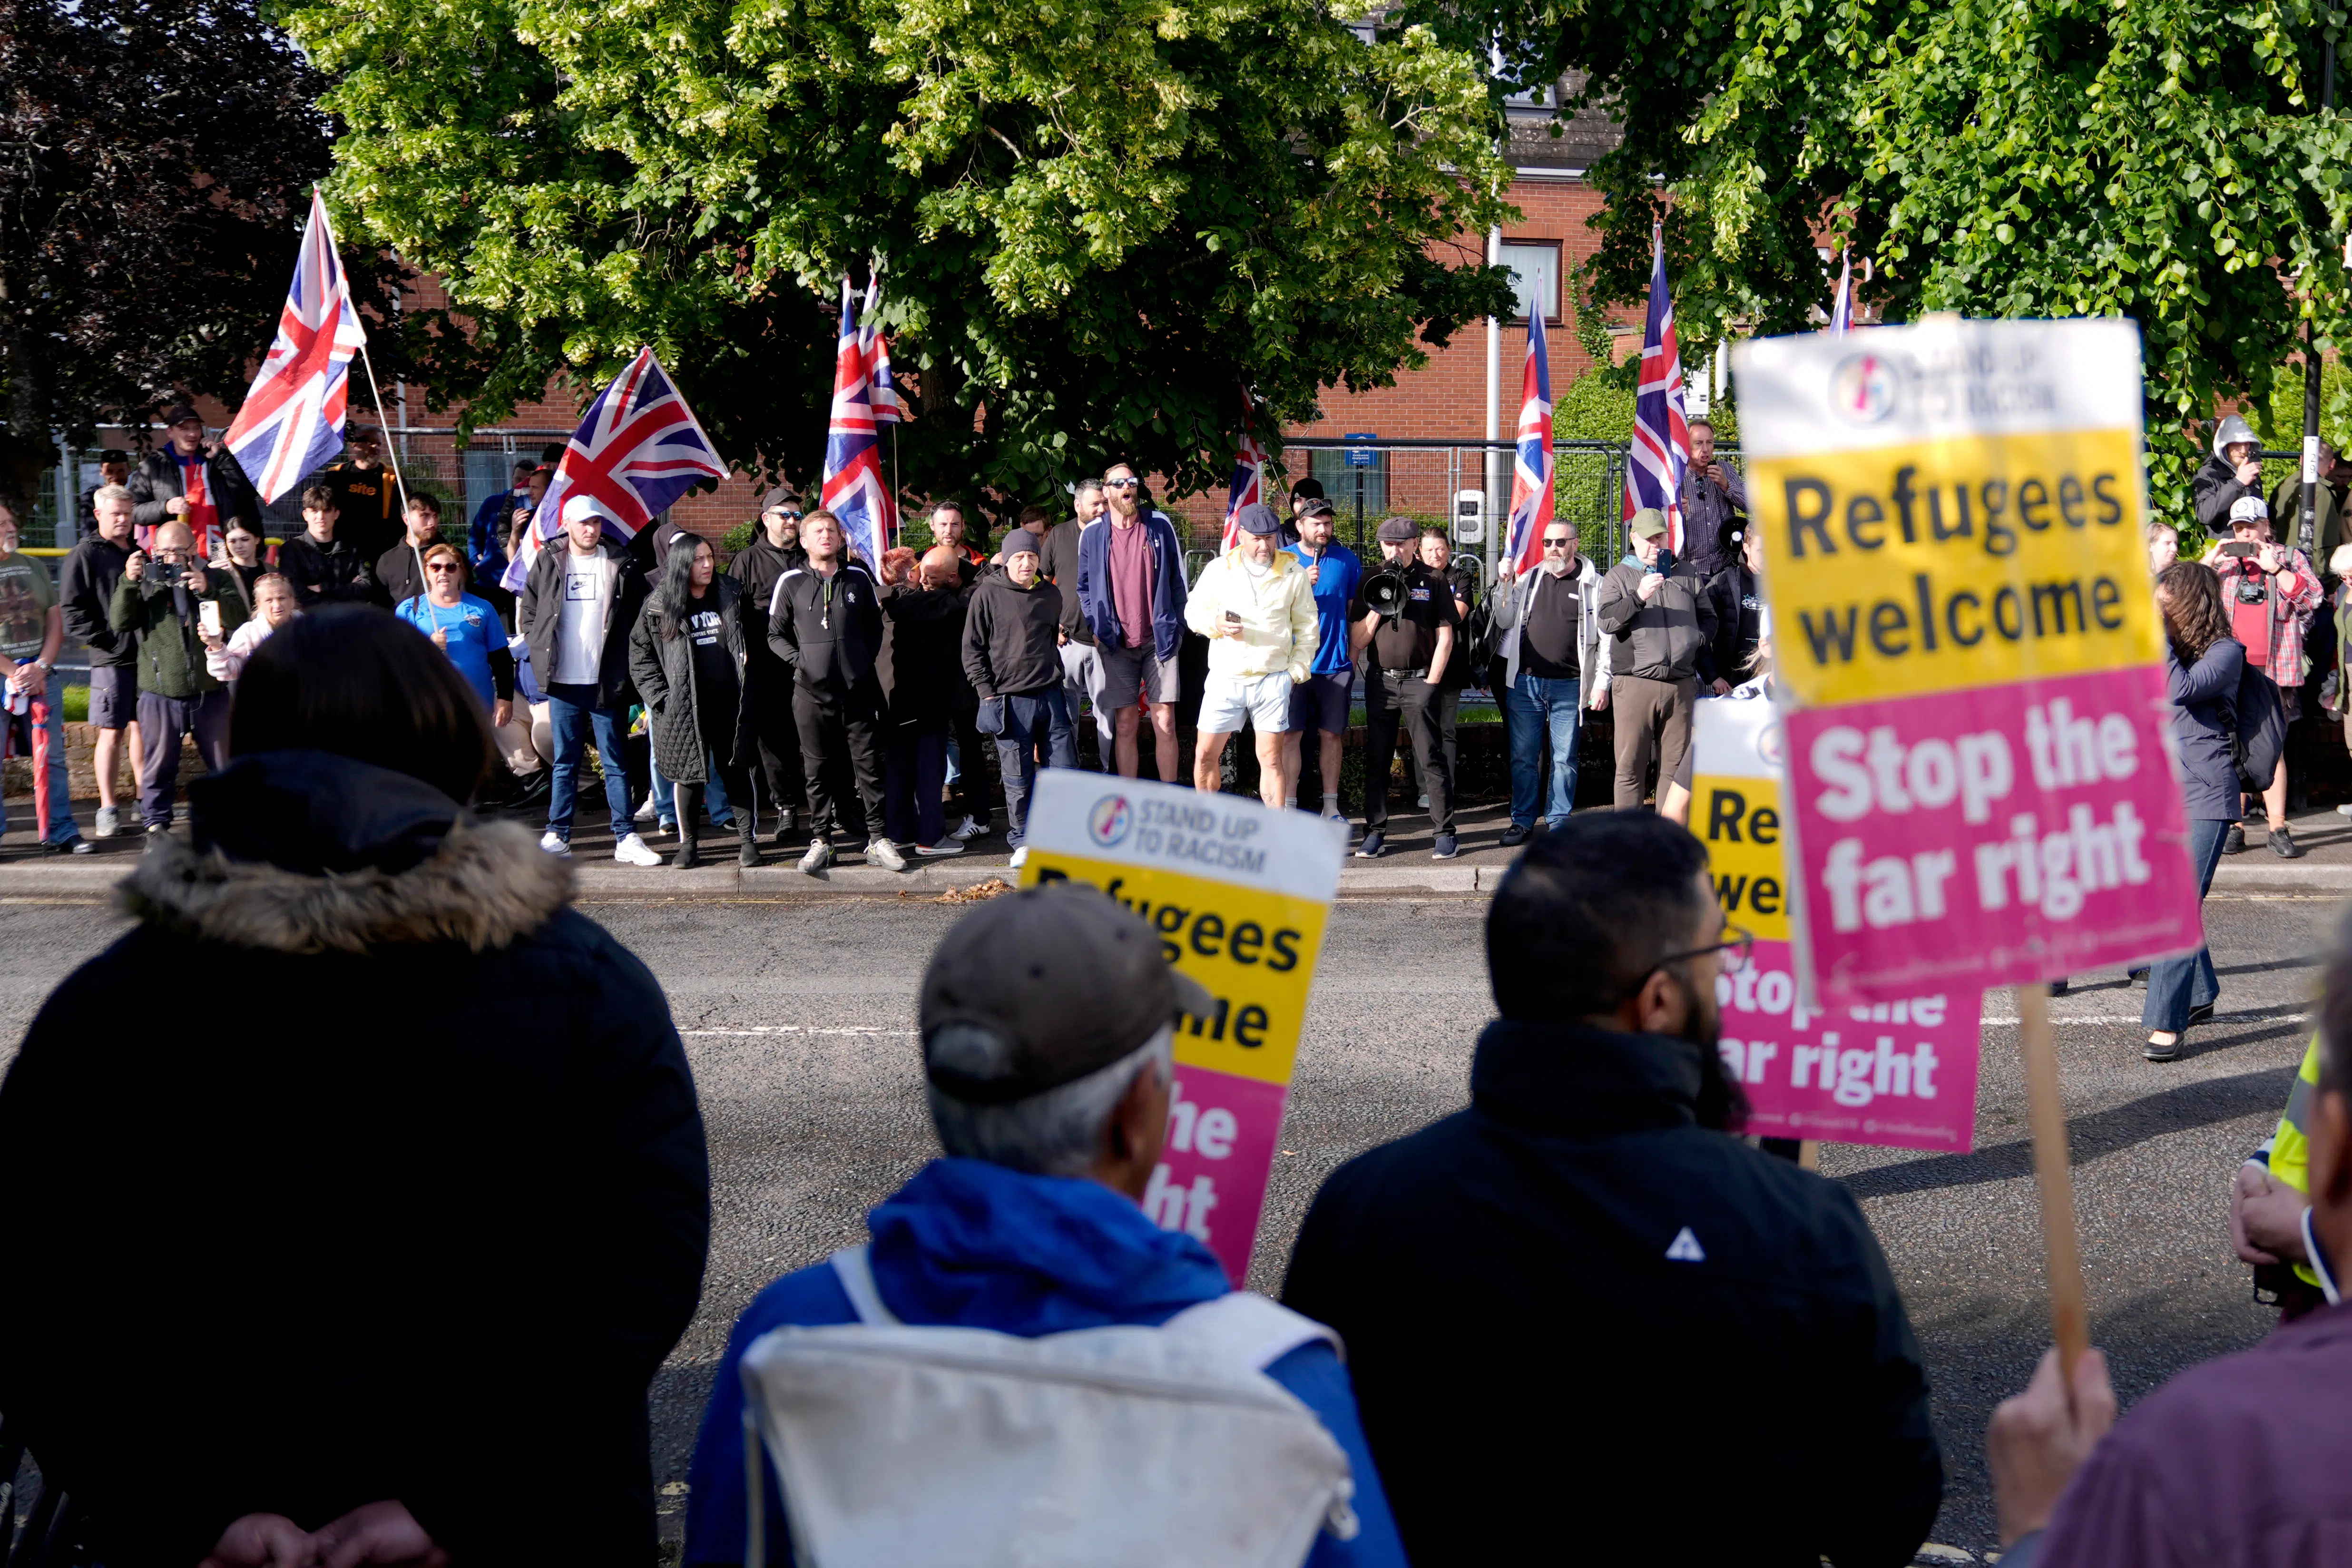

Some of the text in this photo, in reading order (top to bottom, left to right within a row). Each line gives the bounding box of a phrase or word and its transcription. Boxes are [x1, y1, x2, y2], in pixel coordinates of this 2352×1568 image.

[1784, 464, 2122, 558] Refugees
[699, 611, 722, 627] YOR
[1800, 575, 2123, 665] welcome
[1811, 724, 2013, 825] Stop
[2025, 697, 2139, 791] the
[1135, 827, 1268, 874] TO RACISM
[1140, 798, 1260, 841] STAND UP
[1822, 801, 2151, 934] far right
[1717, 1030, 1939, 1107] ar right
[1166, 1080, 1239, 1160] he
